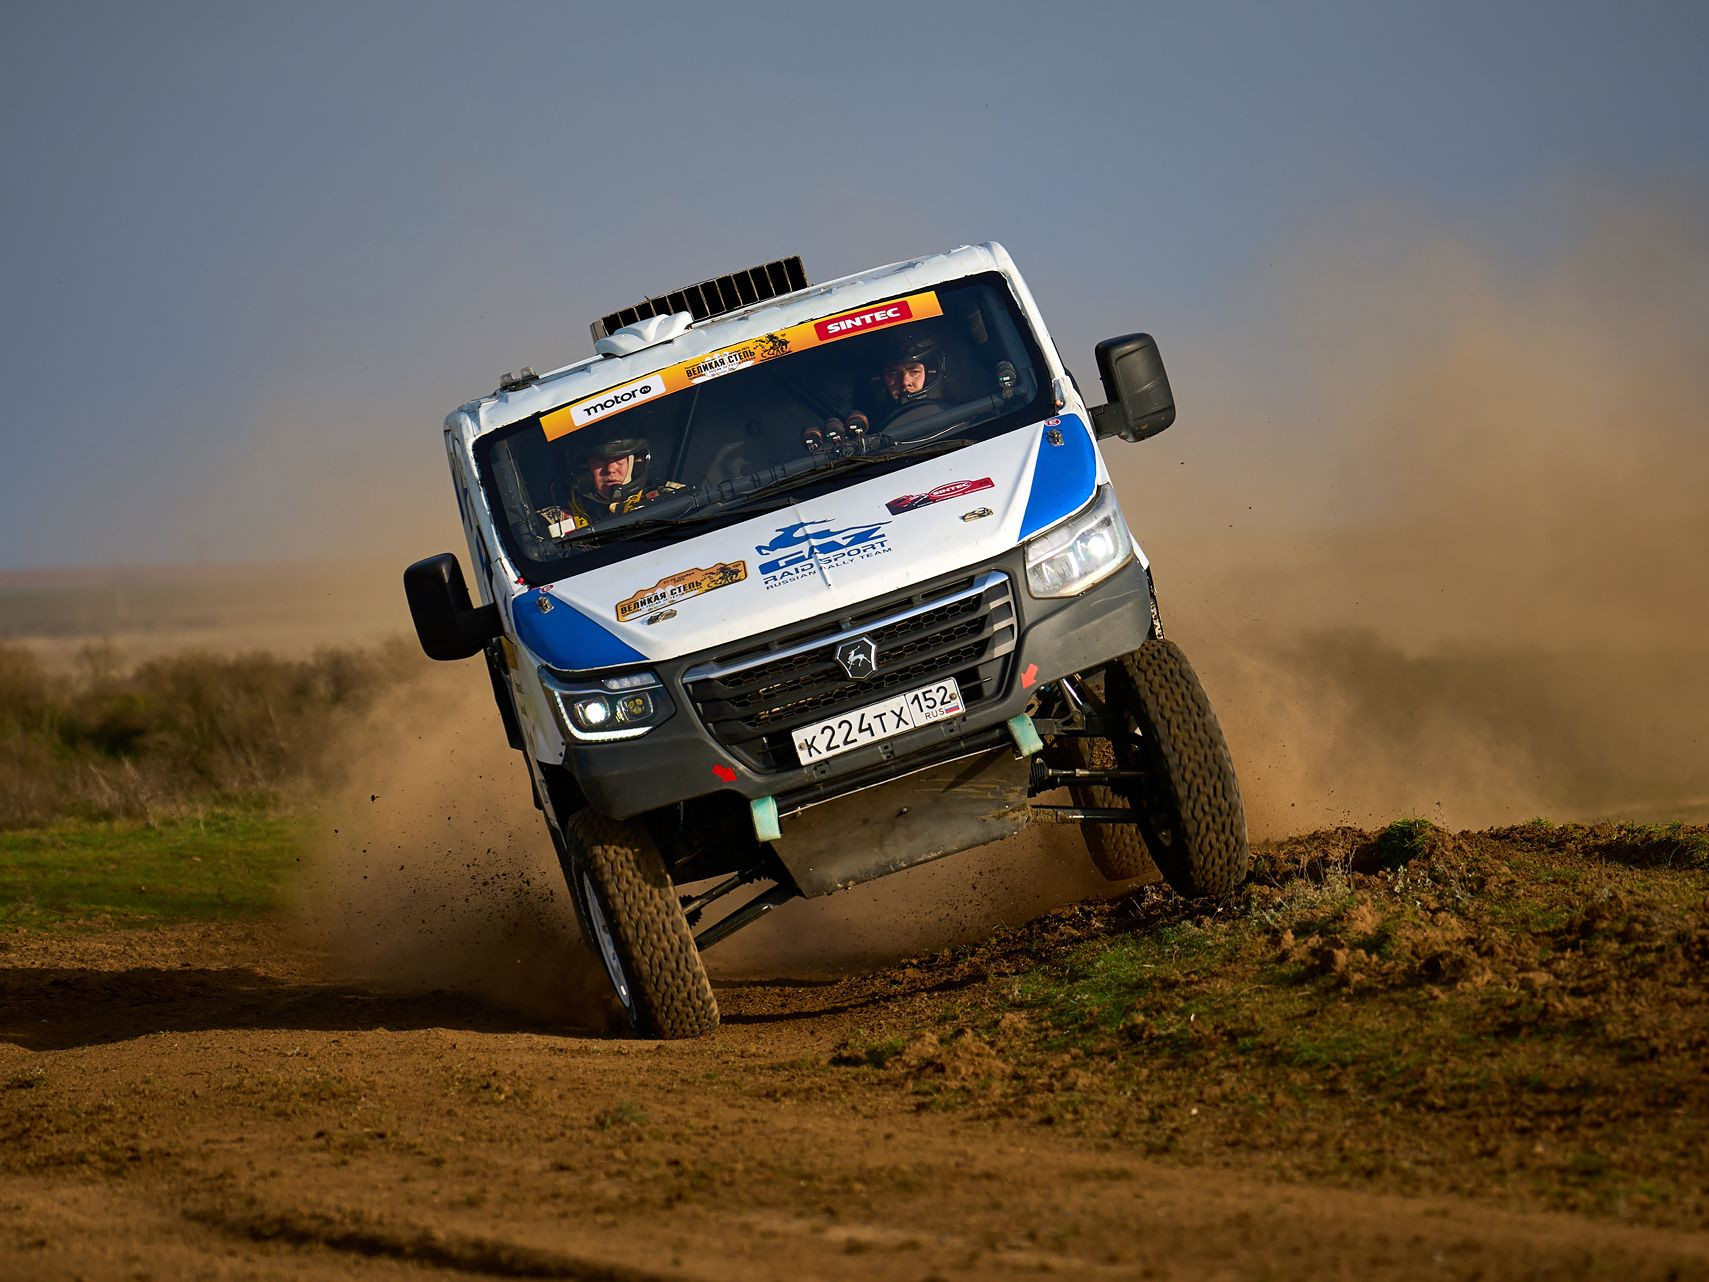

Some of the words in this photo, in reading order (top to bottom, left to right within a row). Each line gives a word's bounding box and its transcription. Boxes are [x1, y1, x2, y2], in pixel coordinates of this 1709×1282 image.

[827, 308, 900, 333] SINTEC
[686, 360, 726, 378] ВЕЛИКАЯ
[728, 349, 756, 364] СТЕПЬ
[583, 388, 638, 416] motor
[758, 526, 886, 576] GAZ
[763, 562, 815, 585] RAID
[819, 540, 888, 565] SPORT
[766, 570, 817, 590] RUSSIAN
[860, 547, 892, 560] TEAM
[620, 592, 667, 615] ВЕЛИКАЯ
[670, 580, 703, 596] СТЕПЬ
[910, 685, 952, 713] 152
[924, 708, 946, 720] RUS
